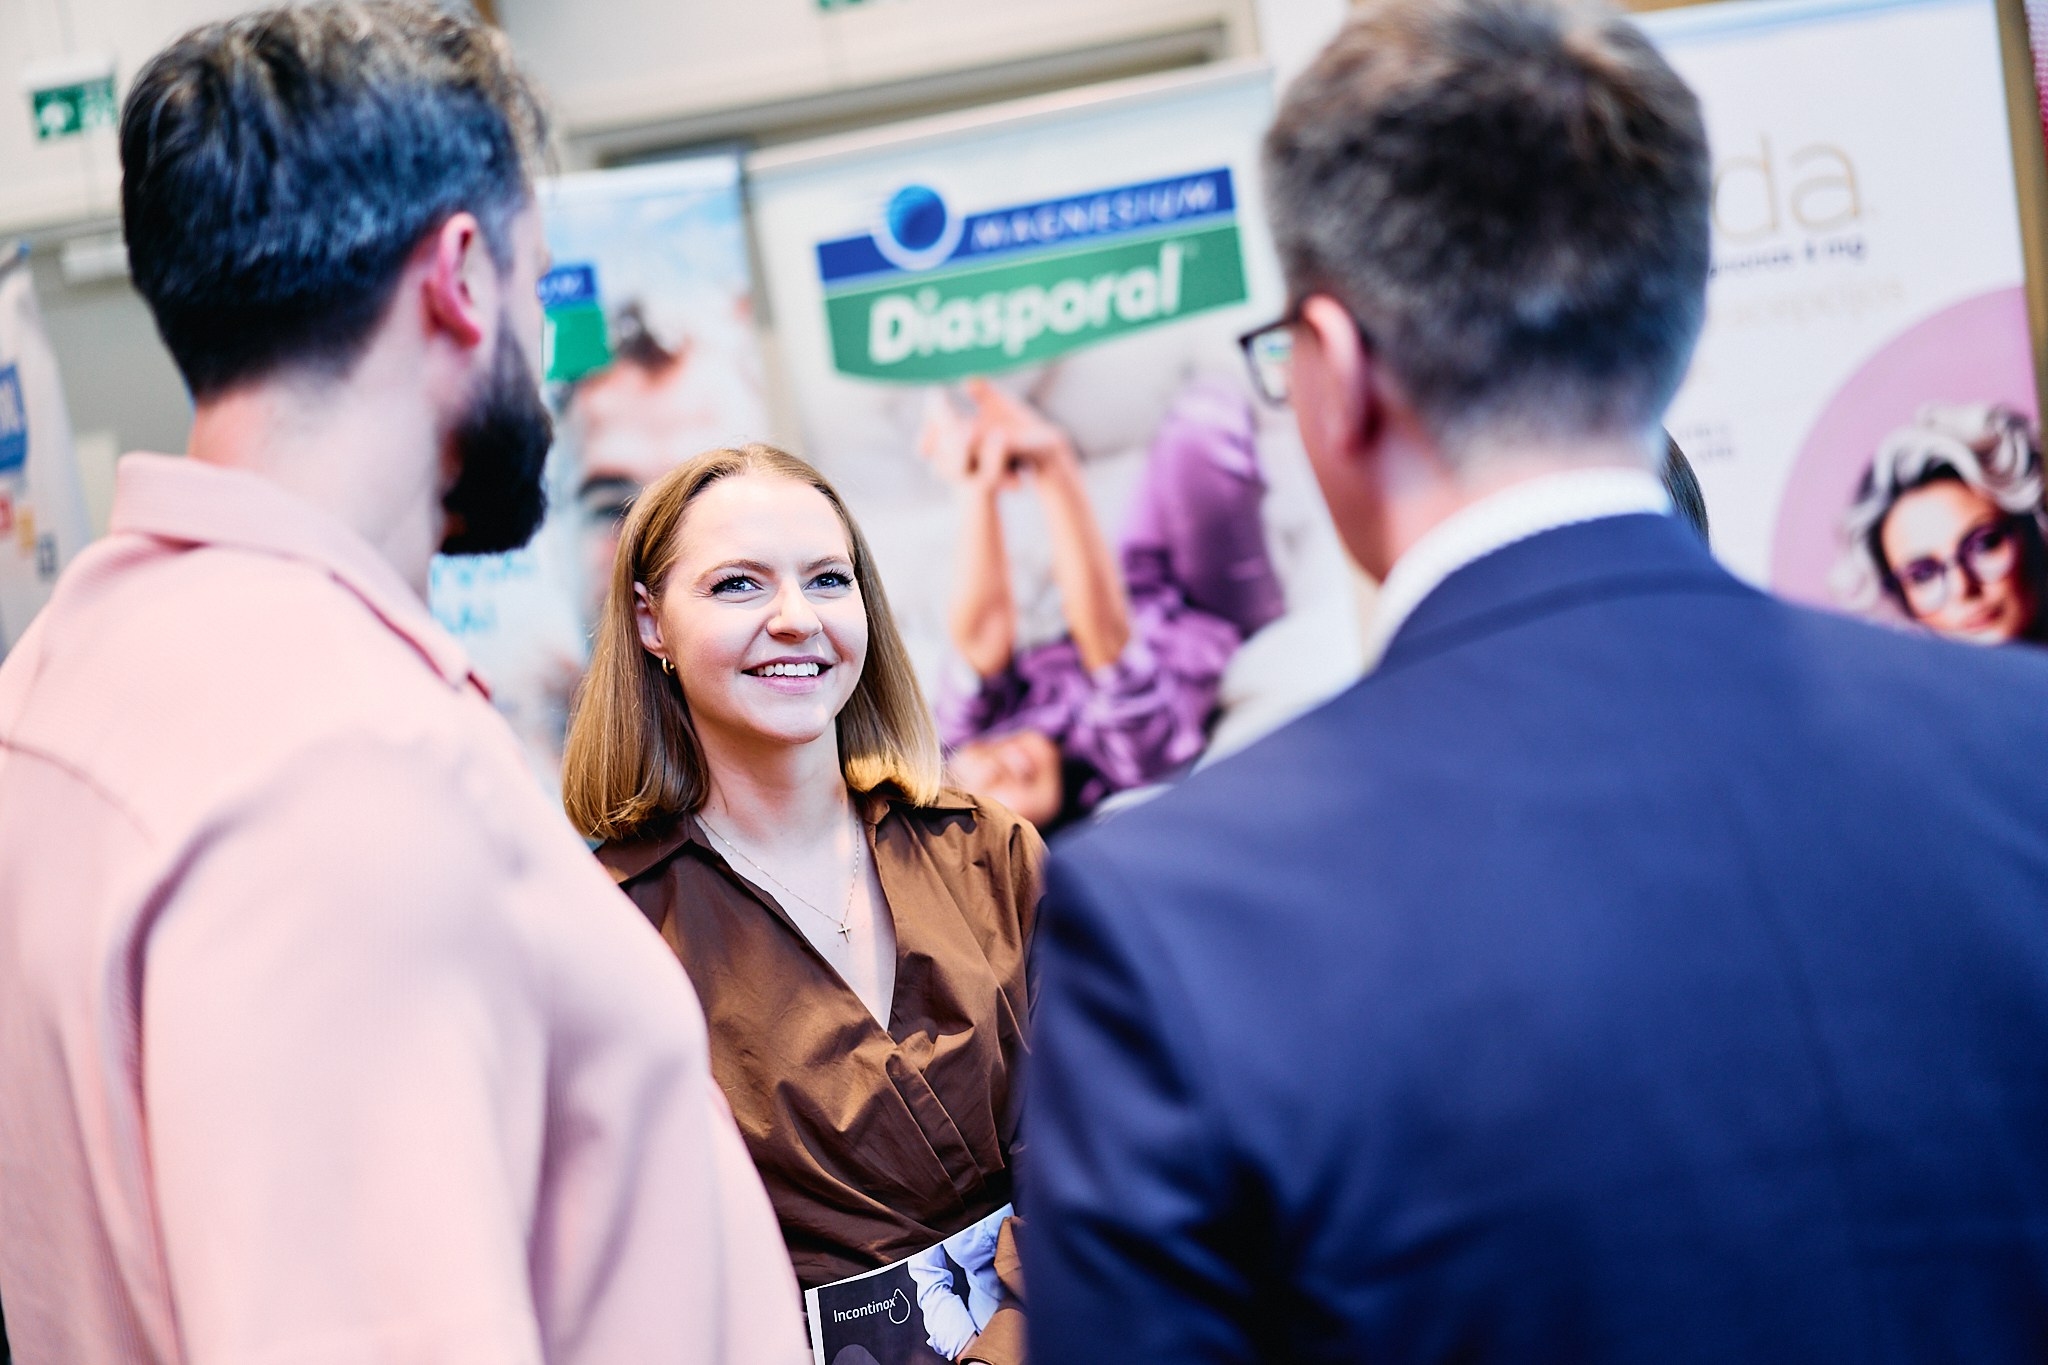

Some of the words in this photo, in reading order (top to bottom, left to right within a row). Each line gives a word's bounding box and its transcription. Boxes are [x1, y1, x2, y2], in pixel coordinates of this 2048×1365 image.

[971, 177, 1217, 251] MAGNESIUM
[868, 241, 1185, 365] Diasporal
[833, 1297, 896, 1323] Incontinox
